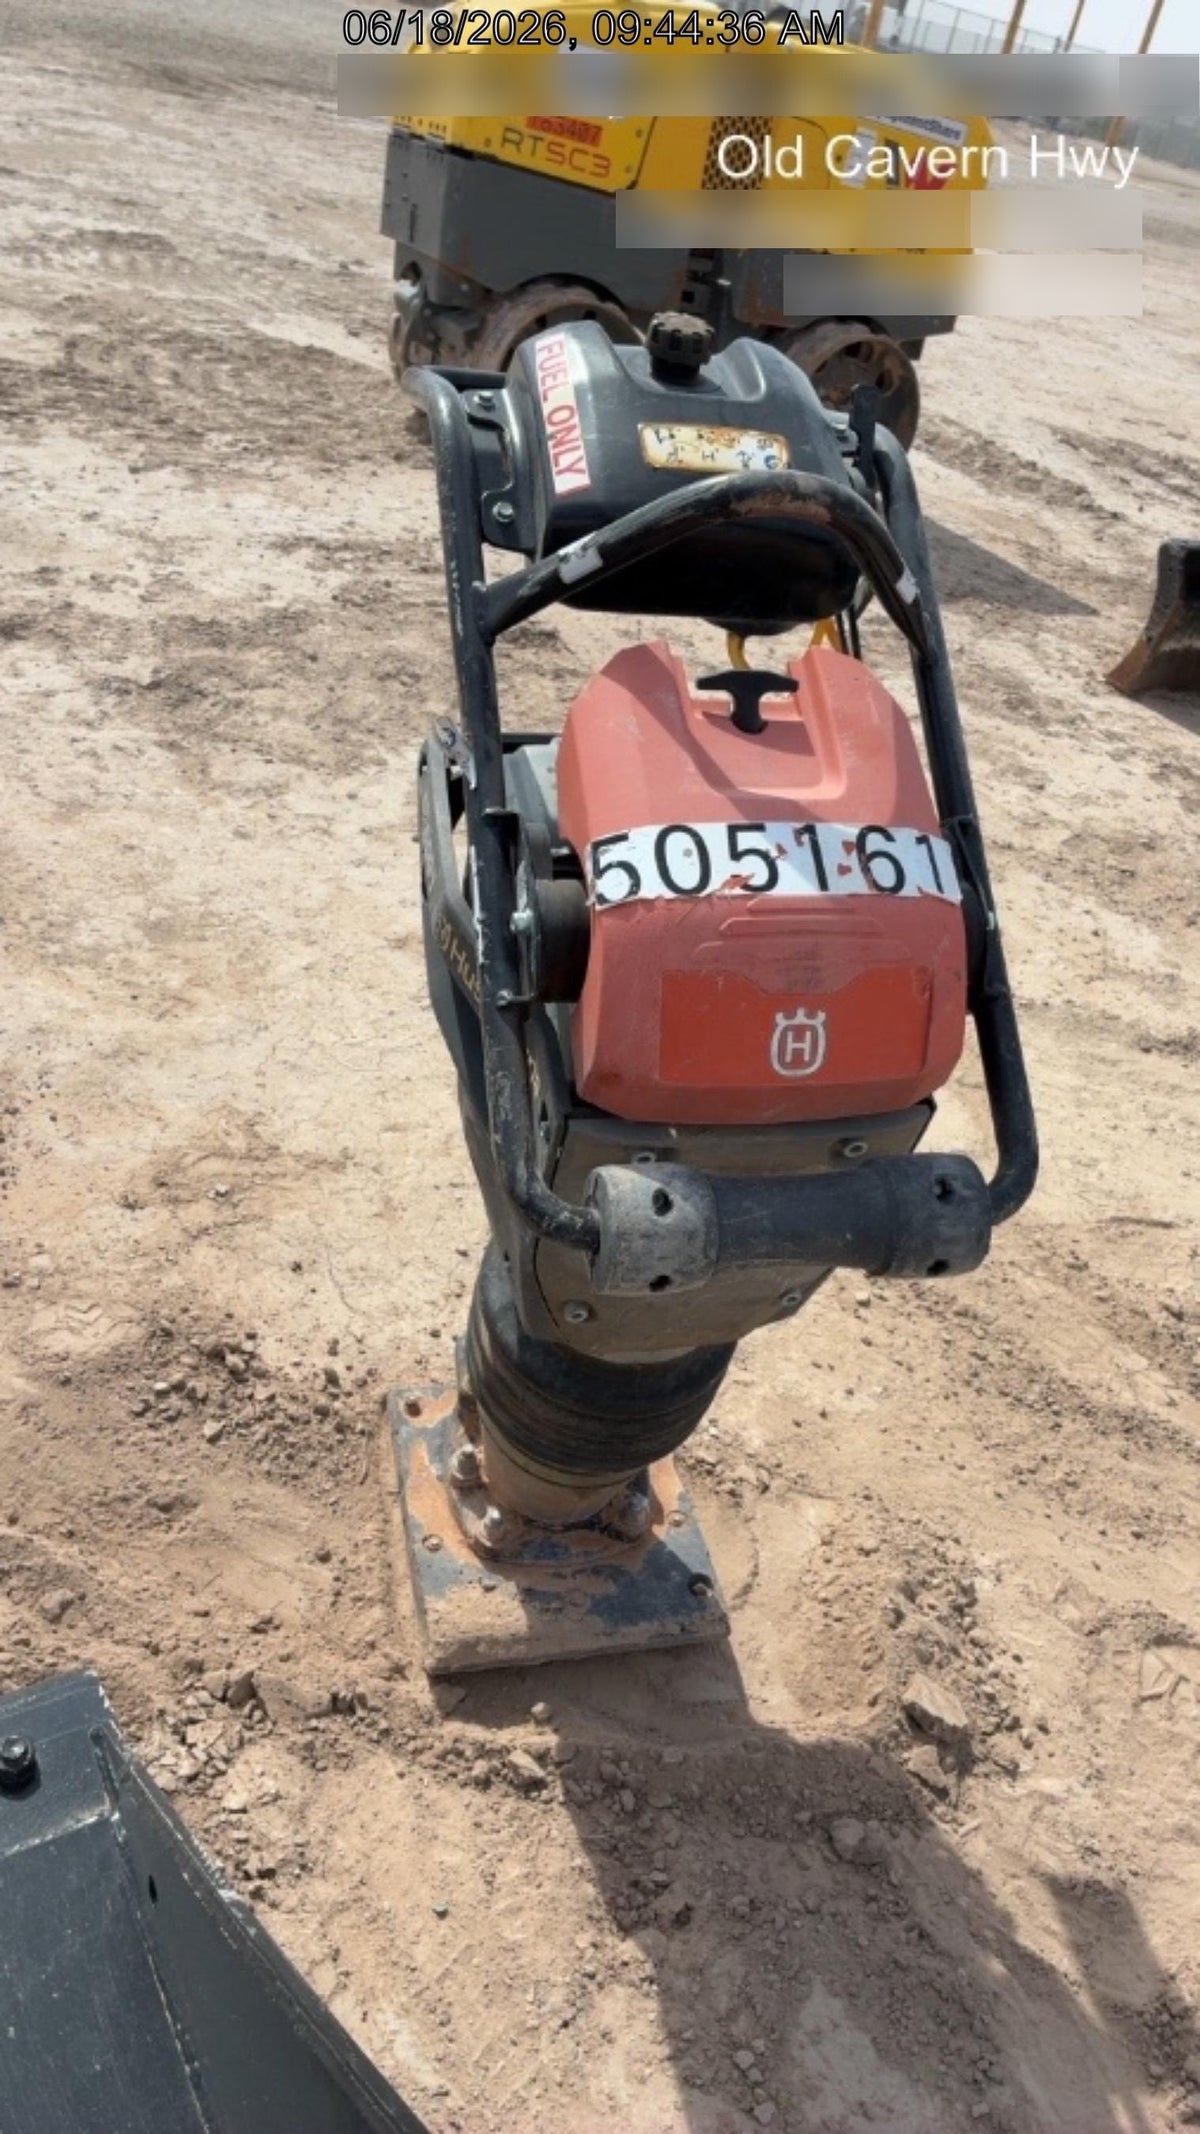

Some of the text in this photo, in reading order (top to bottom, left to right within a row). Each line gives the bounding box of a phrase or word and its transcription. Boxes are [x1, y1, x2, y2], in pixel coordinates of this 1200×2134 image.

[538, 340, 586, 477] FUEL ONLY
[592, 823, 946, 905] 505161
